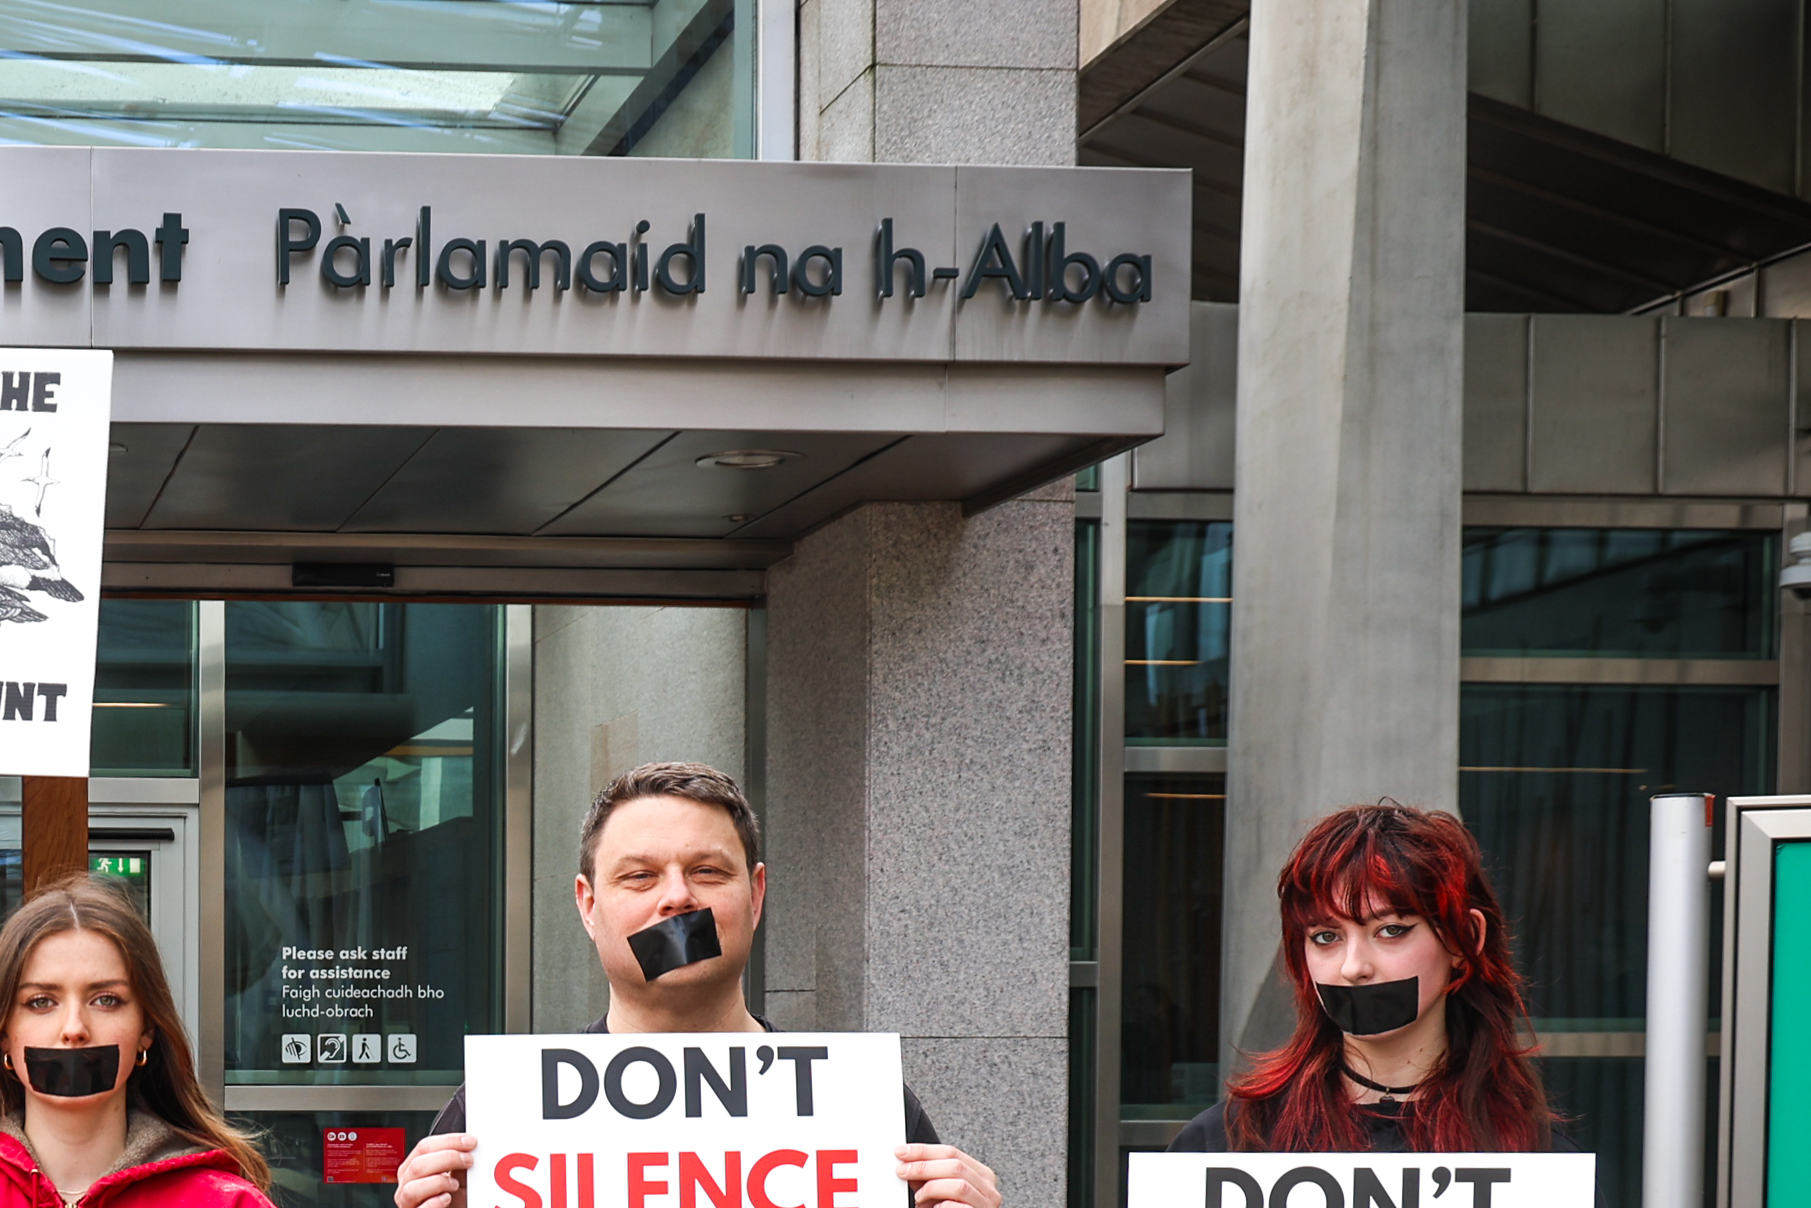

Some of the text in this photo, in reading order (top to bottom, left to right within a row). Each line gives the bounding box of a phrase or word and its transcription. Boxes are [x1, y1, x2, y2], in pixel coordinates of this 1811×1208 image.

[277, 203, 1152, 304] Pàrlamaid na h-Alba
[281, 946, 408, 961] Please ask staff
[281, 965, 391, 980] for assistance
[282, 984, 445, 1002] Faigh cuideachadh bho
[282, 1003, 374, 1018] luchd-obrach
[541, 1045, 829, 1120] DON'T
